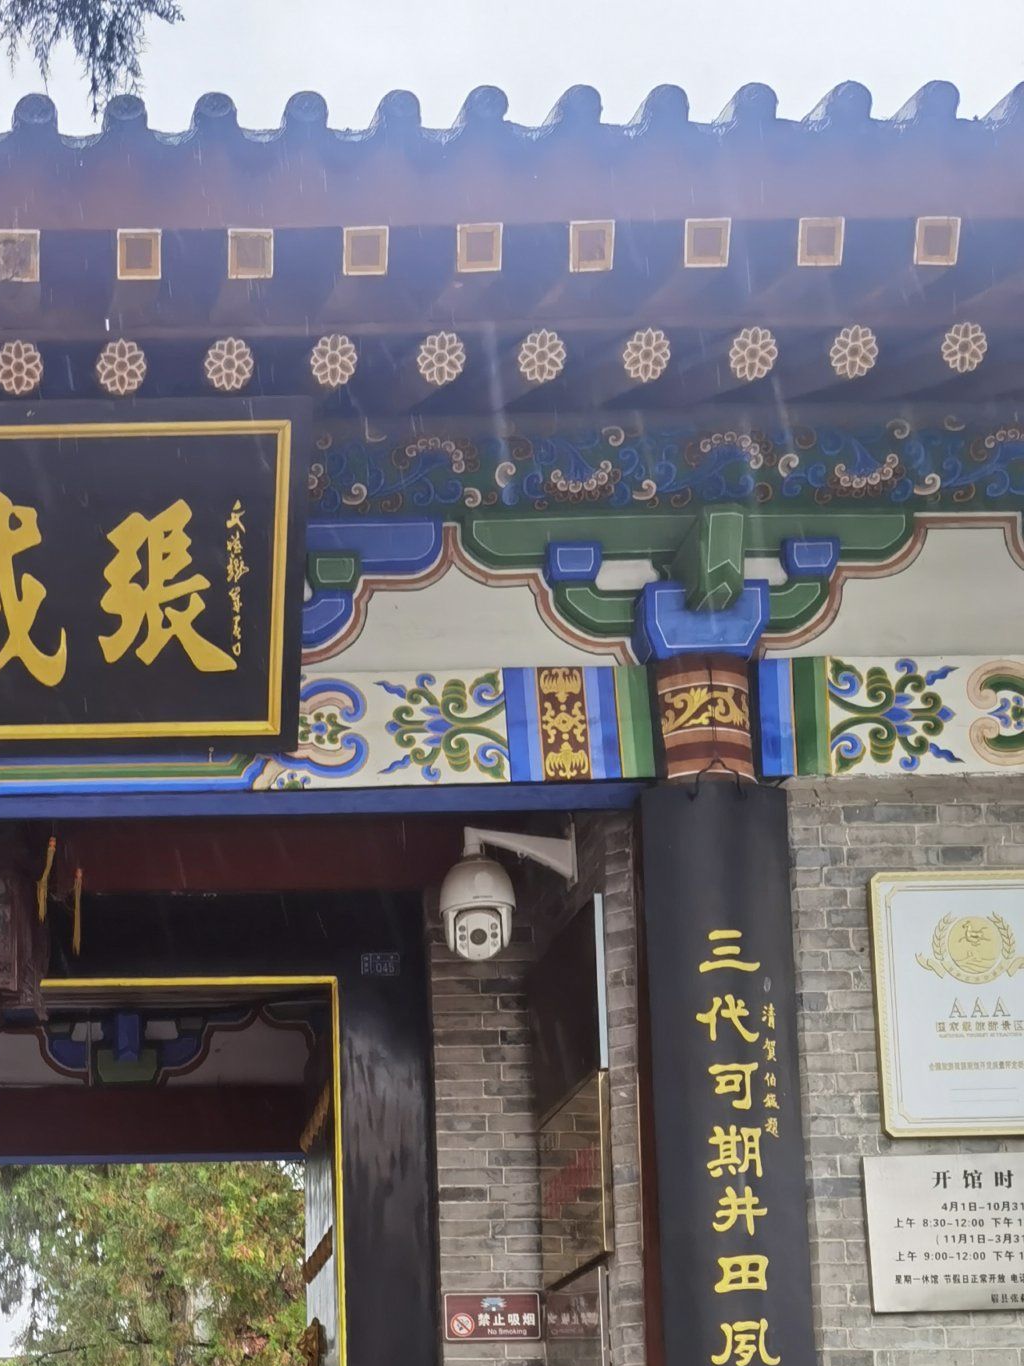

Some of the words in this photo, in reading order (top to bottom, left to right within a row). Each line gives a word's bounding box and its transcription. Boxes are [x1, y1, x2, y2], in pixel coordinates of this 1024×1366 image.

[894, 1217, 916, 1228] 上午
[991, 1217, 1014, 1228] 下午
[896, 1251, 917, 1262] 上午
[993, 1250, 1015, 1261] 下午
[477, 1312, 536, 1327] 禁止吸烟
